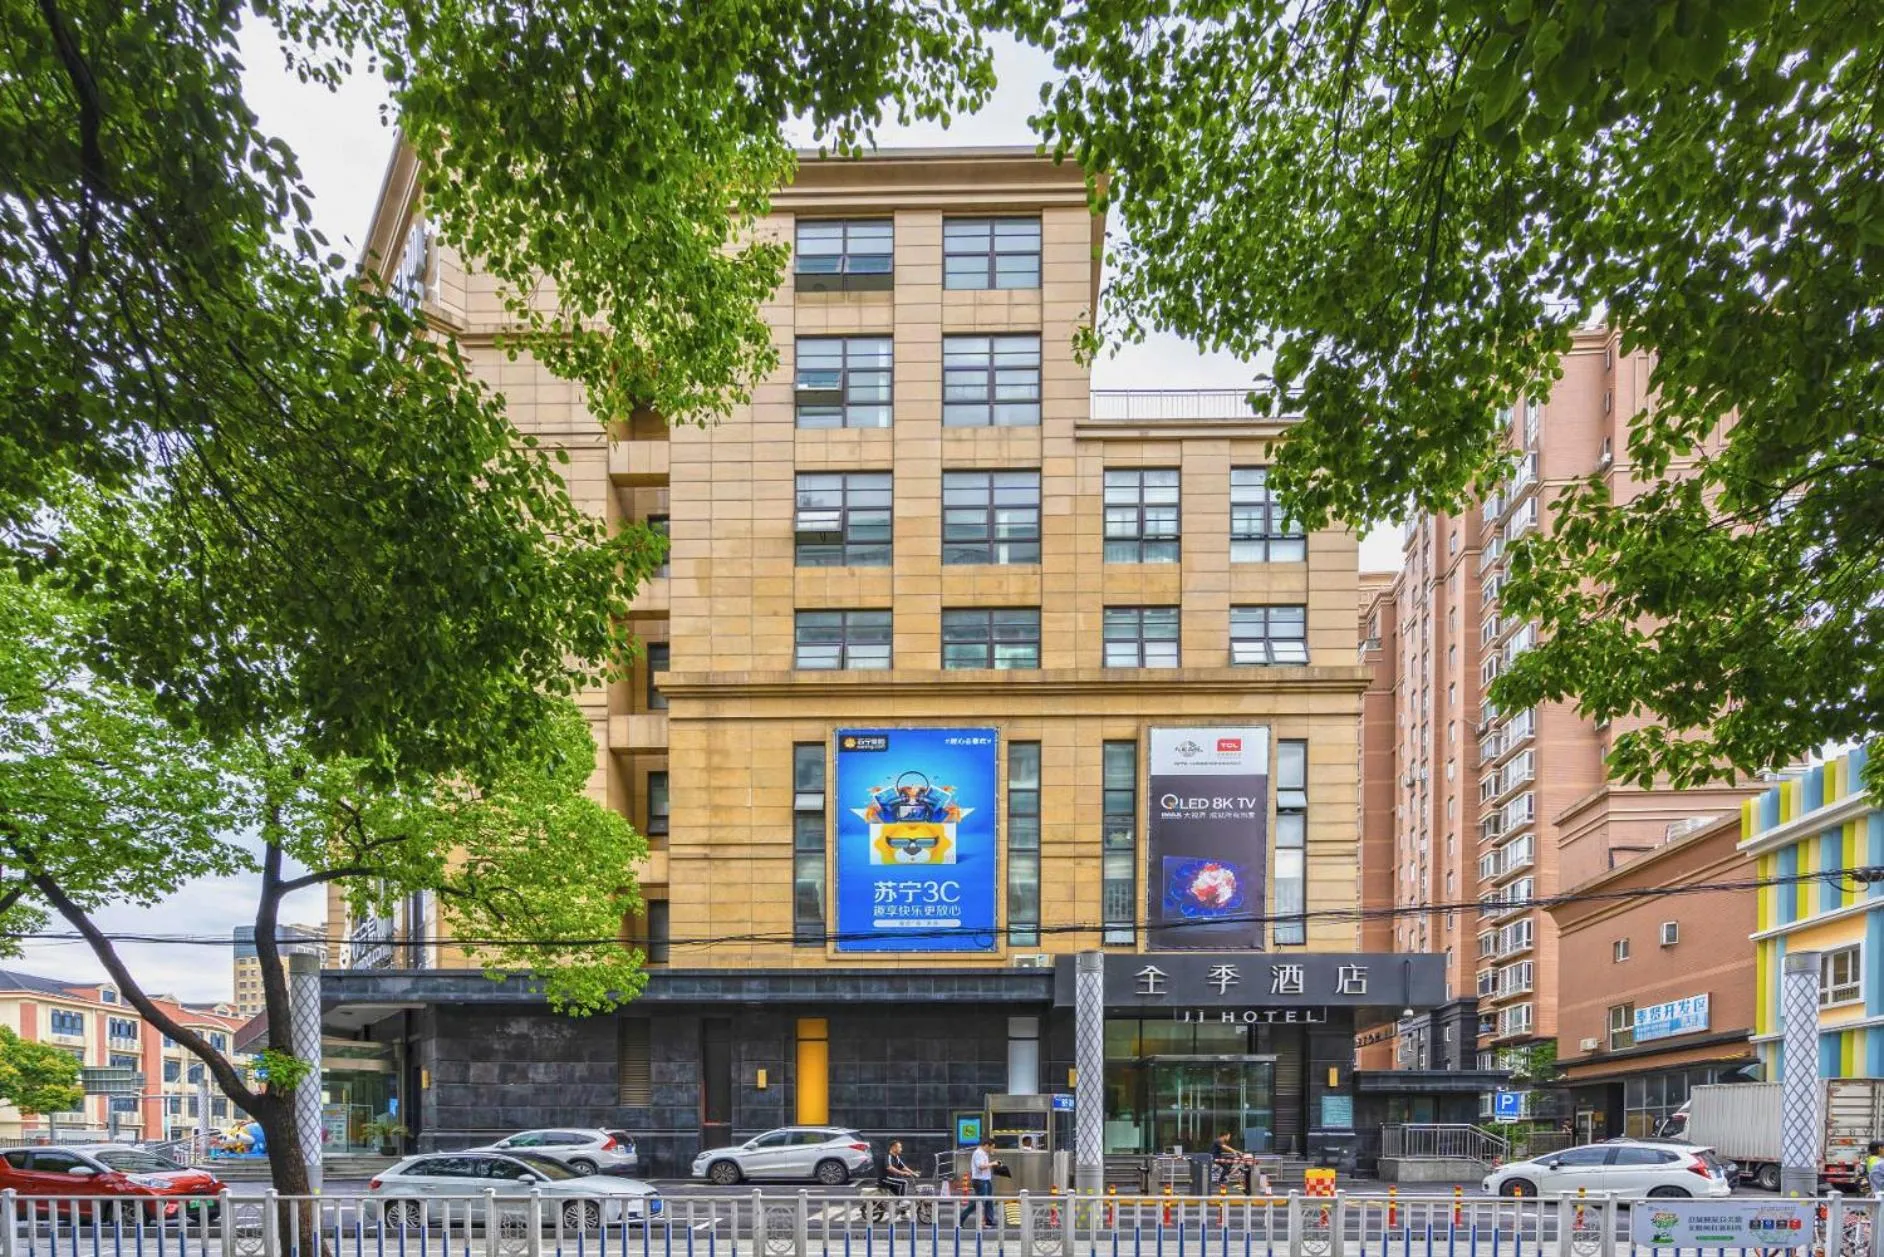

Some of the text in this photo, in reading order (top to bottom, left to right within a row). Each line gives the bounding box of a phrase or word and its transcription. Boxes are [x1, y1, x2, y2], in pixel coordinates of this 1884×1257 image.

[1161, 793, 1256, 810] QLED 8K TV
[874, 881, 960, 902] 苏宁3C
[1134, 964, 1370, 995] 全季酒店
[1222, 1010, 1318, 1023] HOTEL
[1501, 1094, 1514, 1110] P
